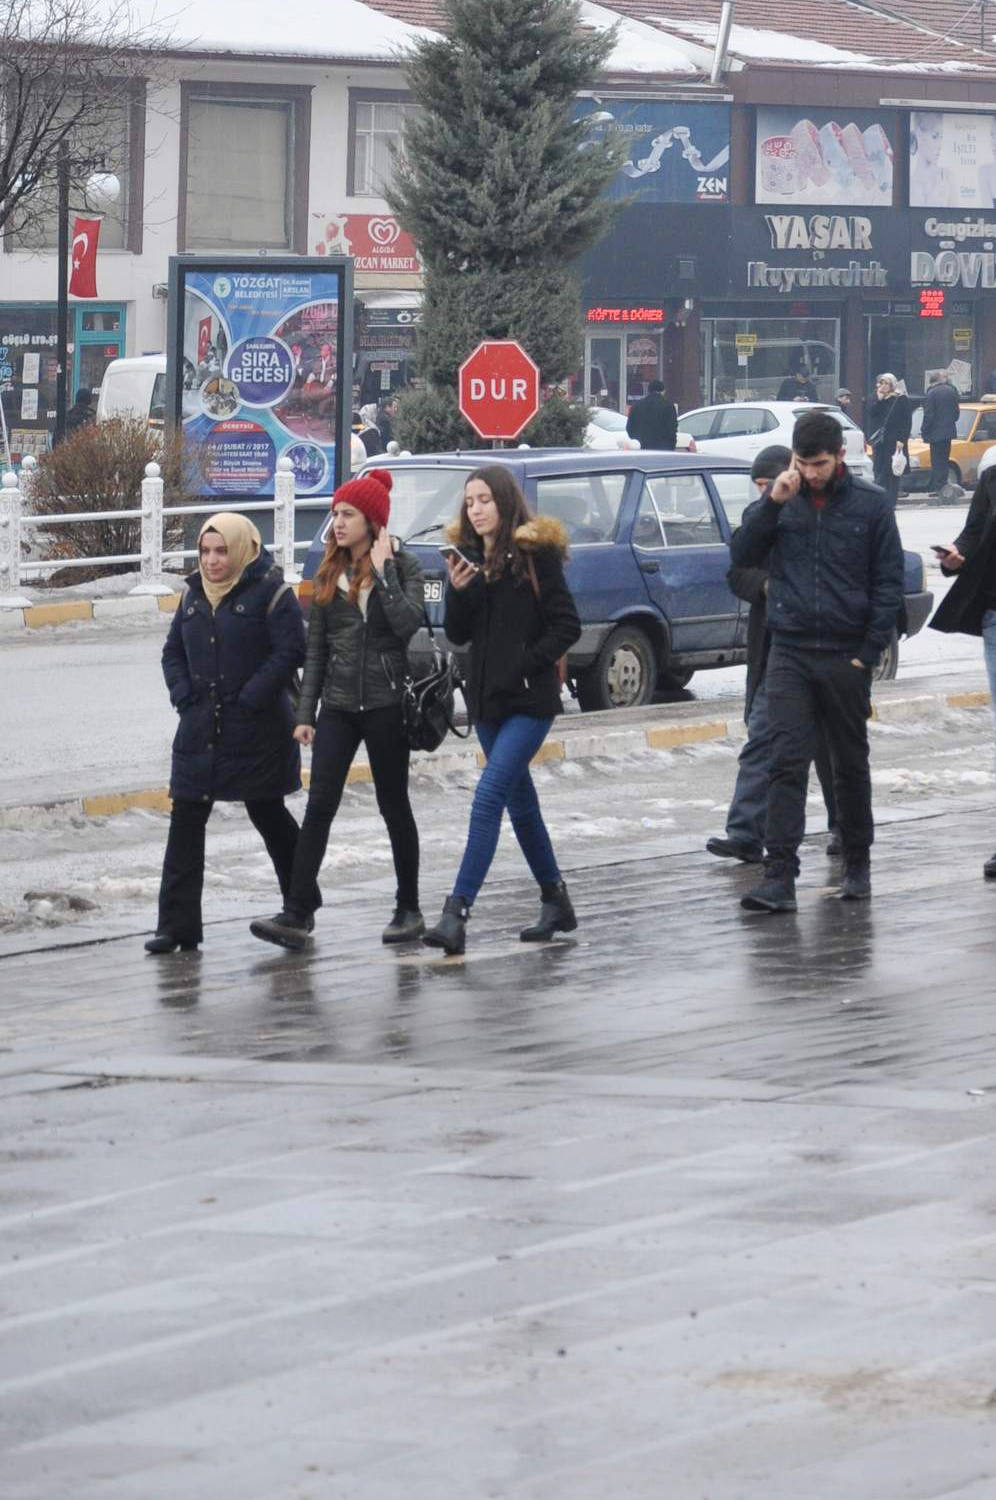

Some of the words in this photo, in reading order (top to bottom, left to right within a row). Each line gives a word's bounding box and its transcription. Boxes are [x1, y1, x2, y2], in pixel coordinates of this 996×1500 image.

[696, 177, 728, 193] ZEN
[764, 214, 873, 260] YAŞAR
[371, 246, 395, 254] ALGIDA
[380, 257, 414, 269] MARKET
[233, 277, 280, 288] YOZGAT
[747, 260, 888, 292] Kuyumculuk
[234, 290, 278, 298] BELEDİYESİ
[588, 307, 621, 321] KÖFTE
[630, 308, 664, 321] DÖNER
[2, 334, 30, 346] GÜÇLÜ
[241, 352, 280, 367] SIRA
[231, 364, 290, 383] GECESİ
[470, 379, 528, 401] DUR
